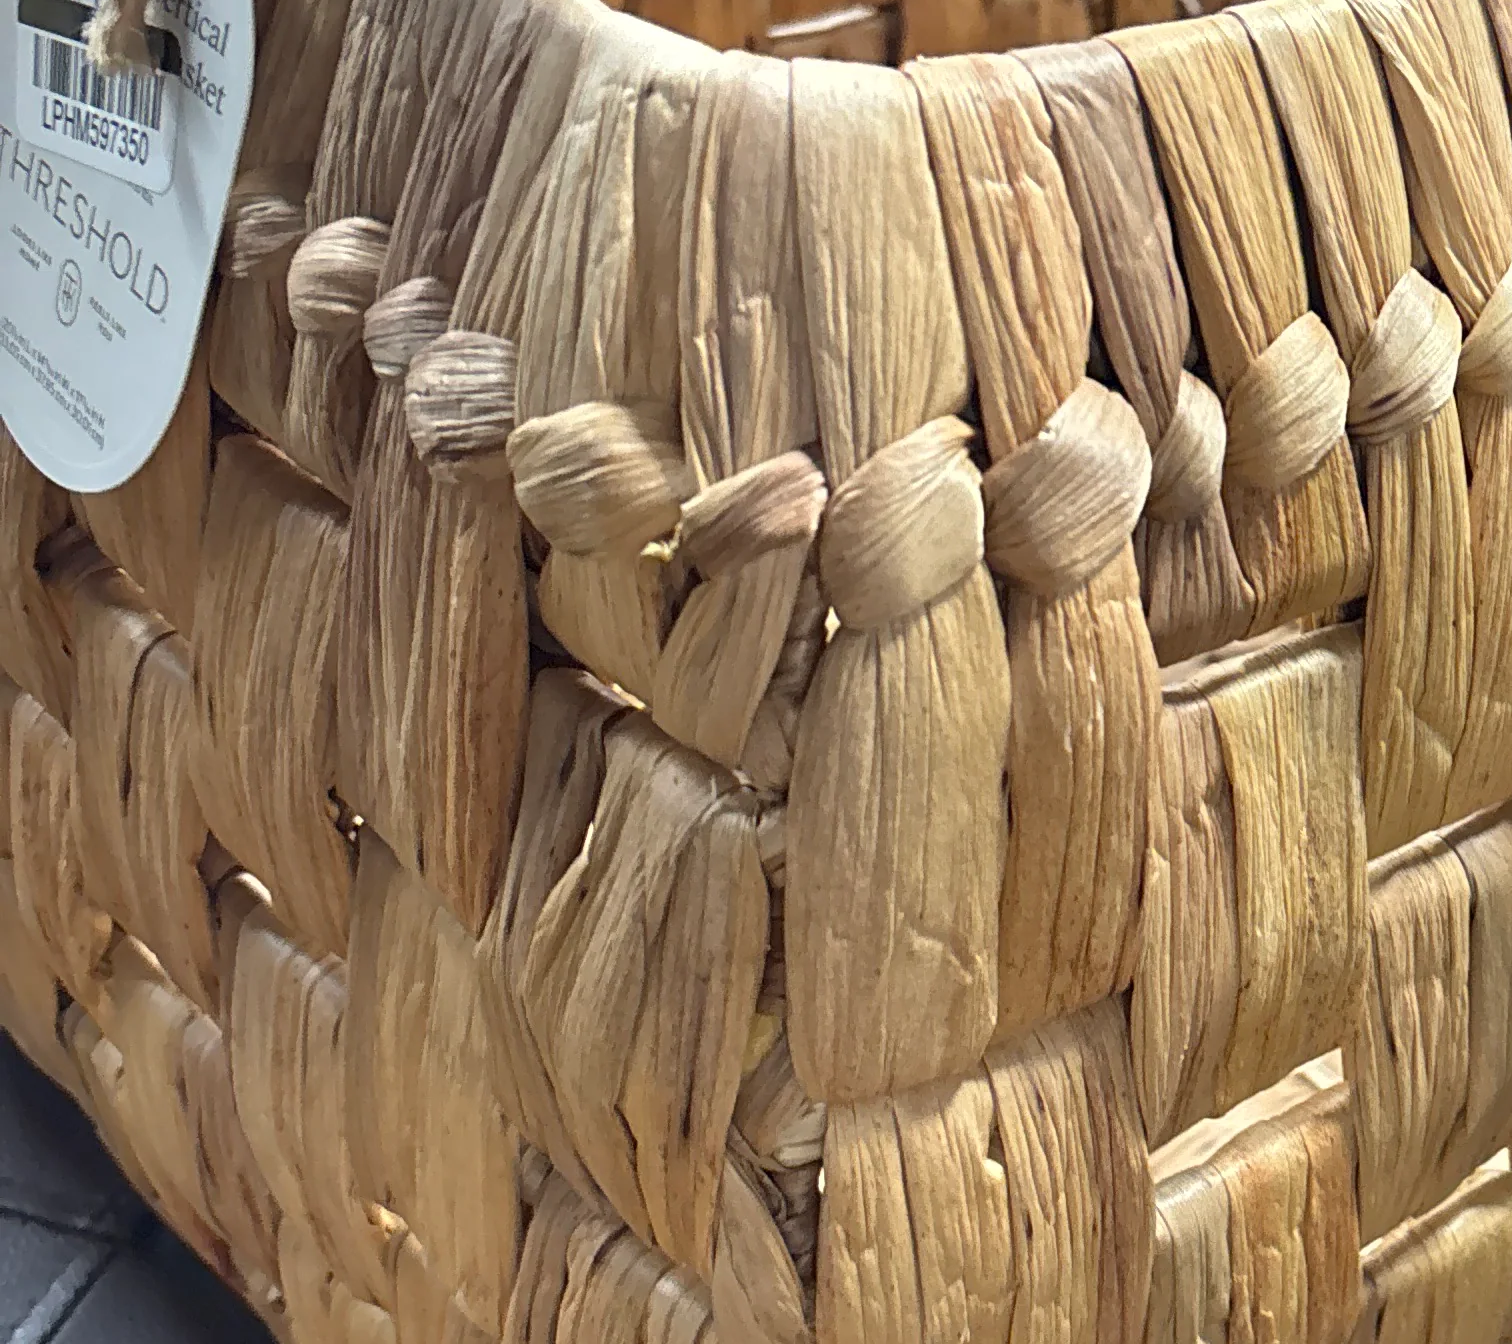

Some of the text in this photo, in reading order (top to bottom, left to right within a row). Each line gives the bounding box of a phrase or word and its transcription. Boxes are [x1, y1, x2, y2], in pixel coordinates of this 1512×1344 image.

[183, 61, 227, 115] sket
[42, 95, 149, 166] LPHM597350
[0, 123, 169, 315] THRESHOLD
